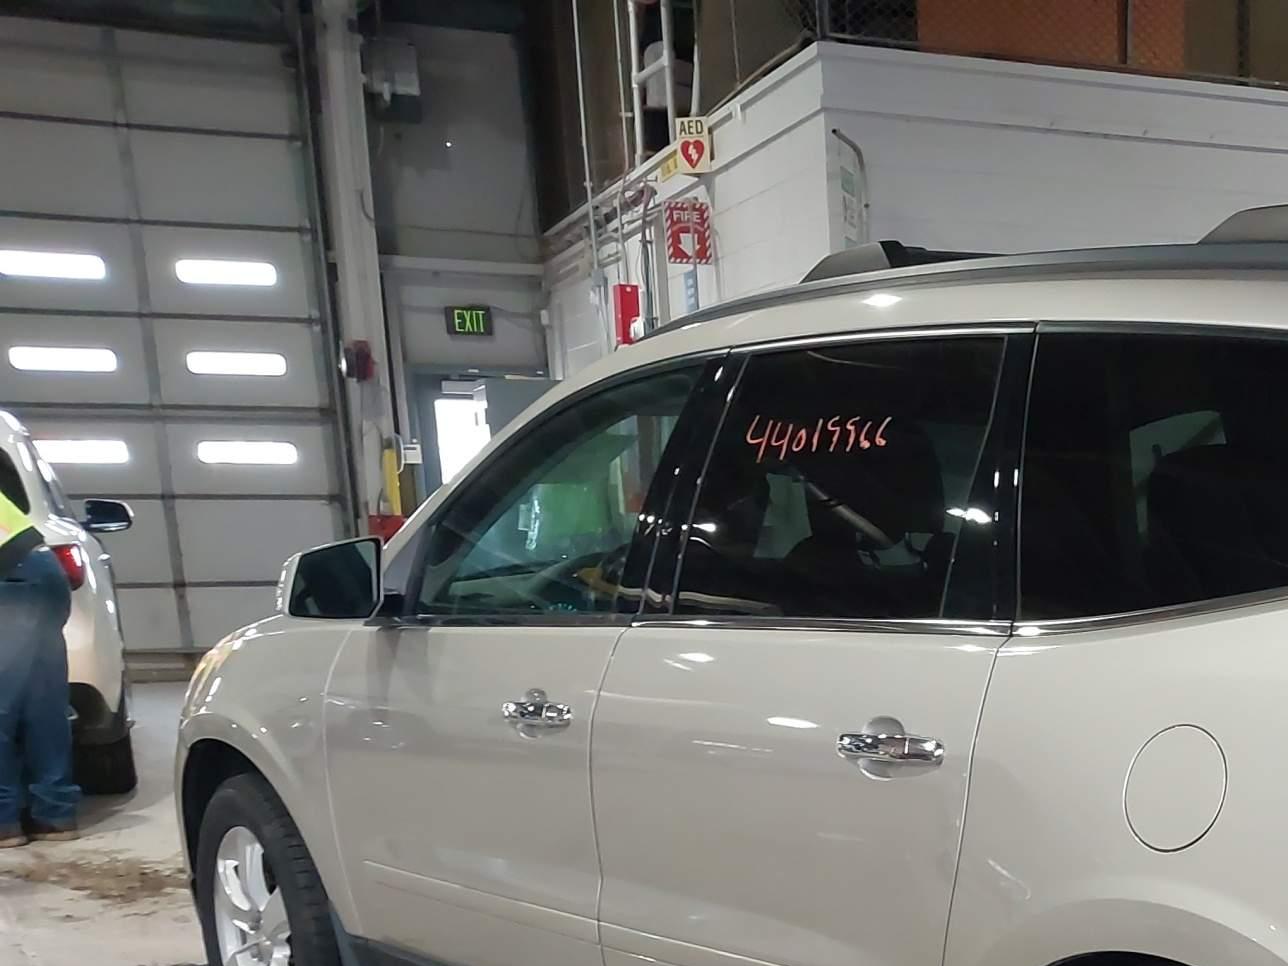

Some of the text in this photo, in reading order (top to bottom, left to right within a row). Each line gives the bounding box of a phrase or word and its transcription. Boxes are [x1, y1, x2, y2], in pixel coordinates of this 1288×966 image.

[679, 119, 704, 136] AED
[454, 309, 485, 332] EXIT
[746, 414, 893, 463] 44019966
